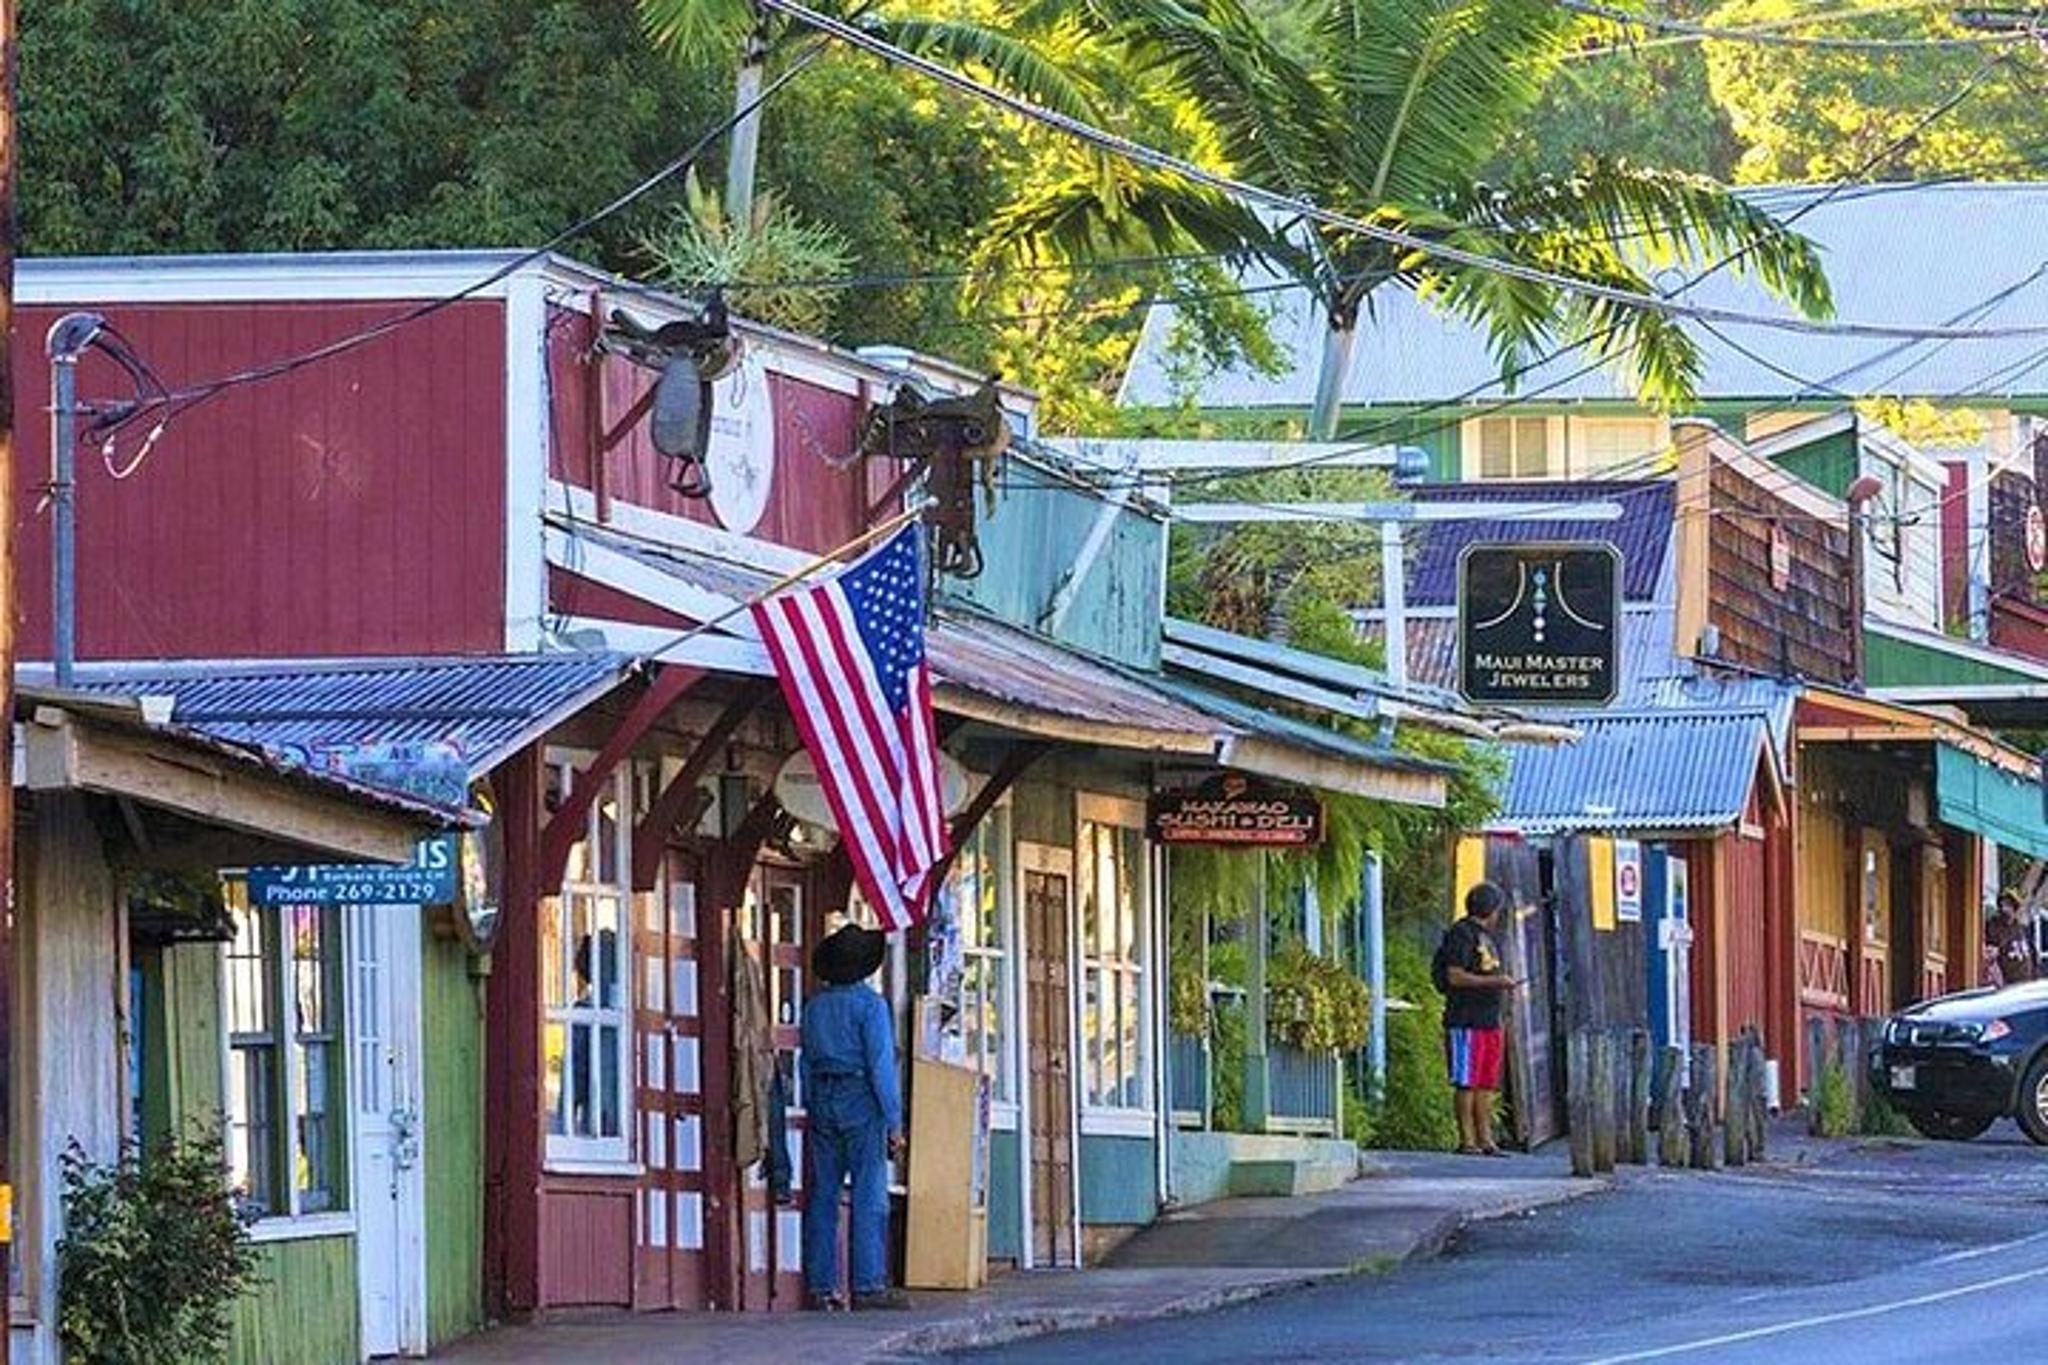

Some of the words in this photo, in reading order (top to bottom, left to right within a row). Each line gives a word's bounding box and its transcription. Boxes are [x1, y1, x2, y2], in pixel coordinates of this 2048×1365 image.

[1475, 654, 1522, 669] MAUI
[1525, 654, 1603, 670] MASTER
[1488, 671, 1591, 688] JEWELERS
[266, 885, 328, 901] Phone
[334, 884, 436, 901] 269-2129
